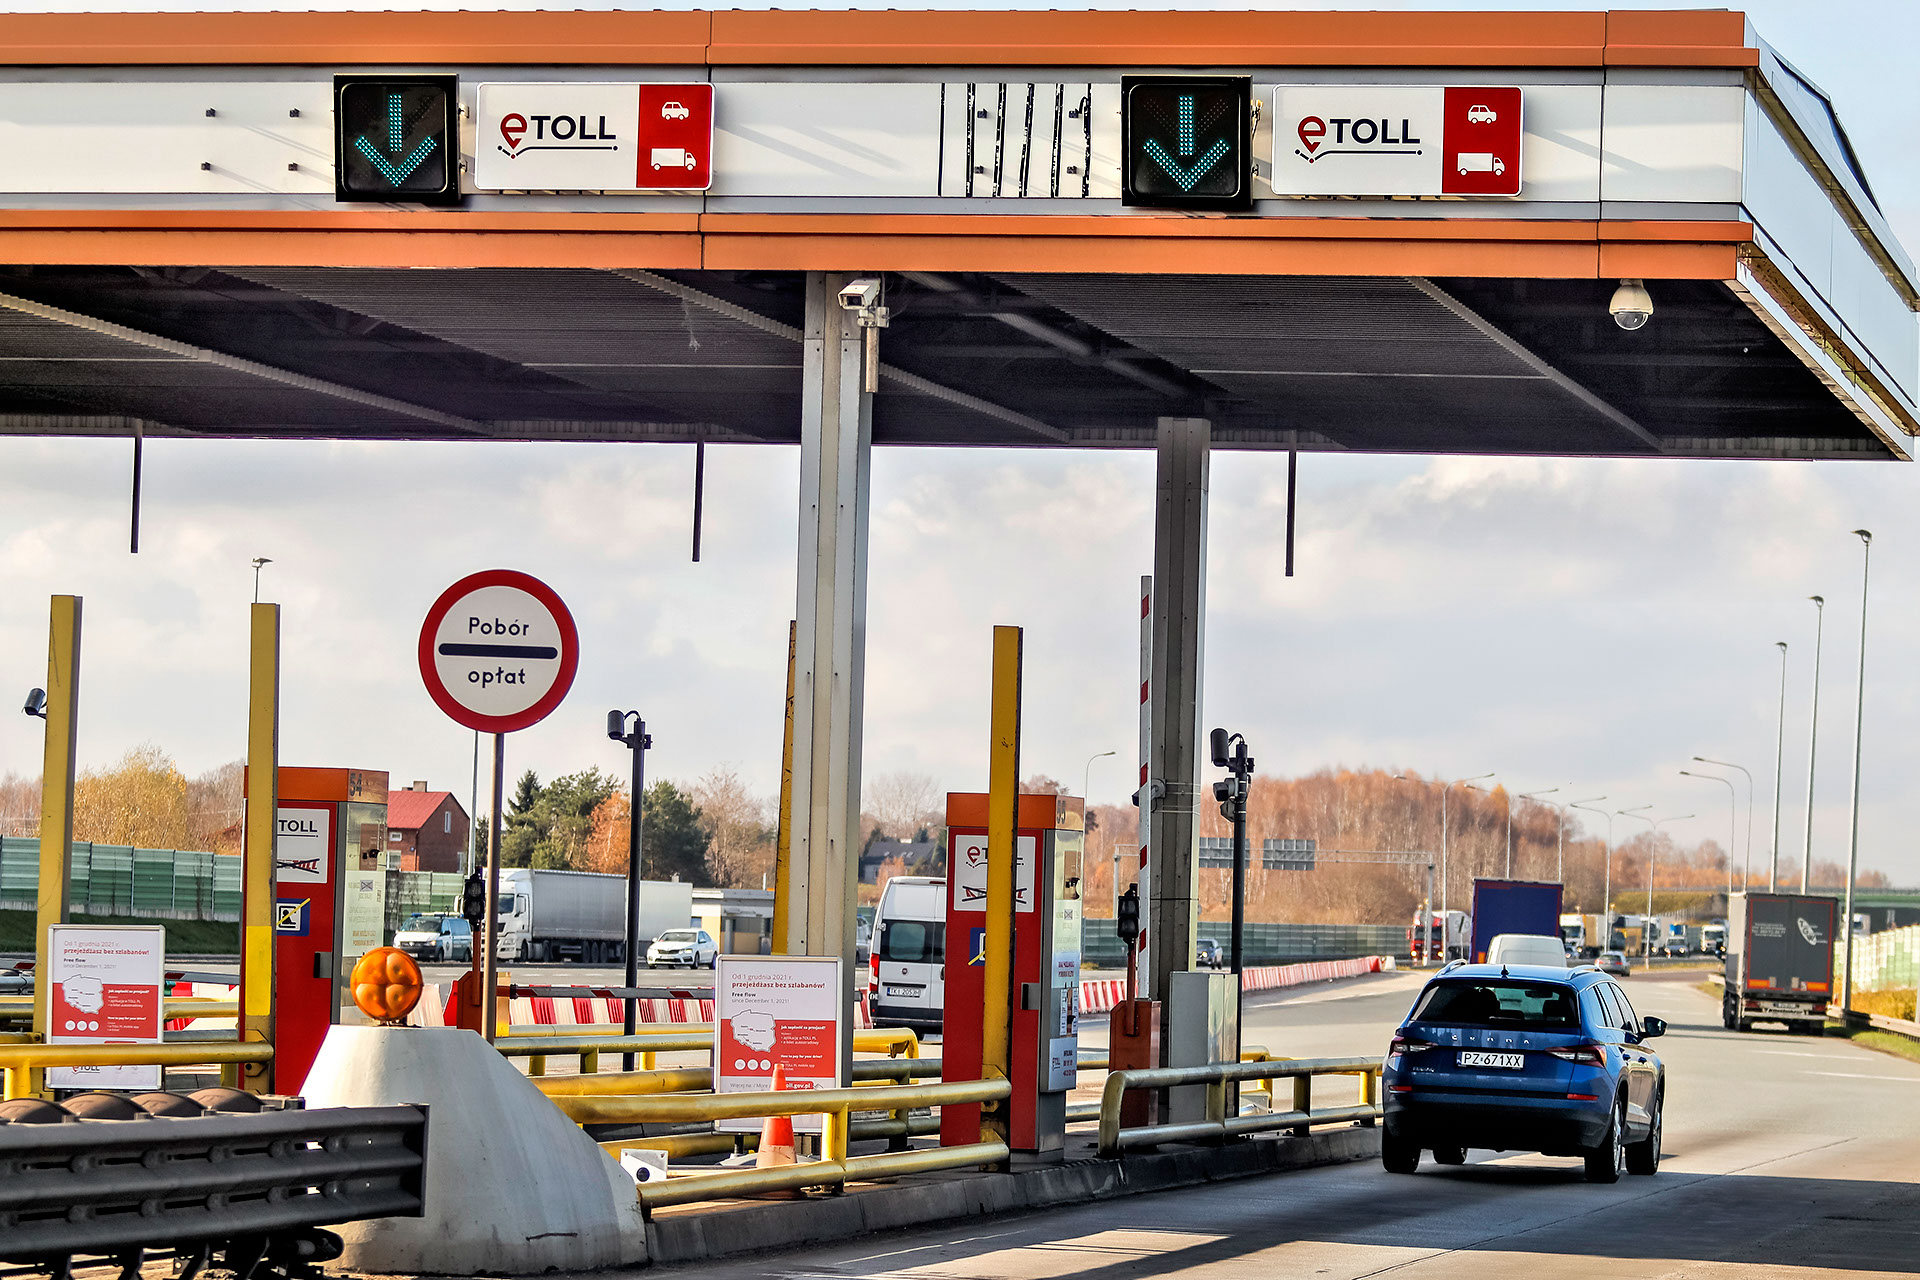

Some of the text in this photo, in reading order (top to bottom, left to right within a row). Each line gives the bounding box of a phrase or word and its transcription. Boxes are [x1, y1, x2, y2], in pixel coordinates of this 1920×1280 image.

[500, 113, 616, 150] eTOLL
[1298, 116, 1420, 154] eTOLL
[469, 617, 529, 636] Pobór
[468, 667, 525, 688] opłat
[349, 772, 362, 797] 54
[278, 820, 318, 832] TOLL
[1464, 1053, 1521, 1067] PZ 671XX
